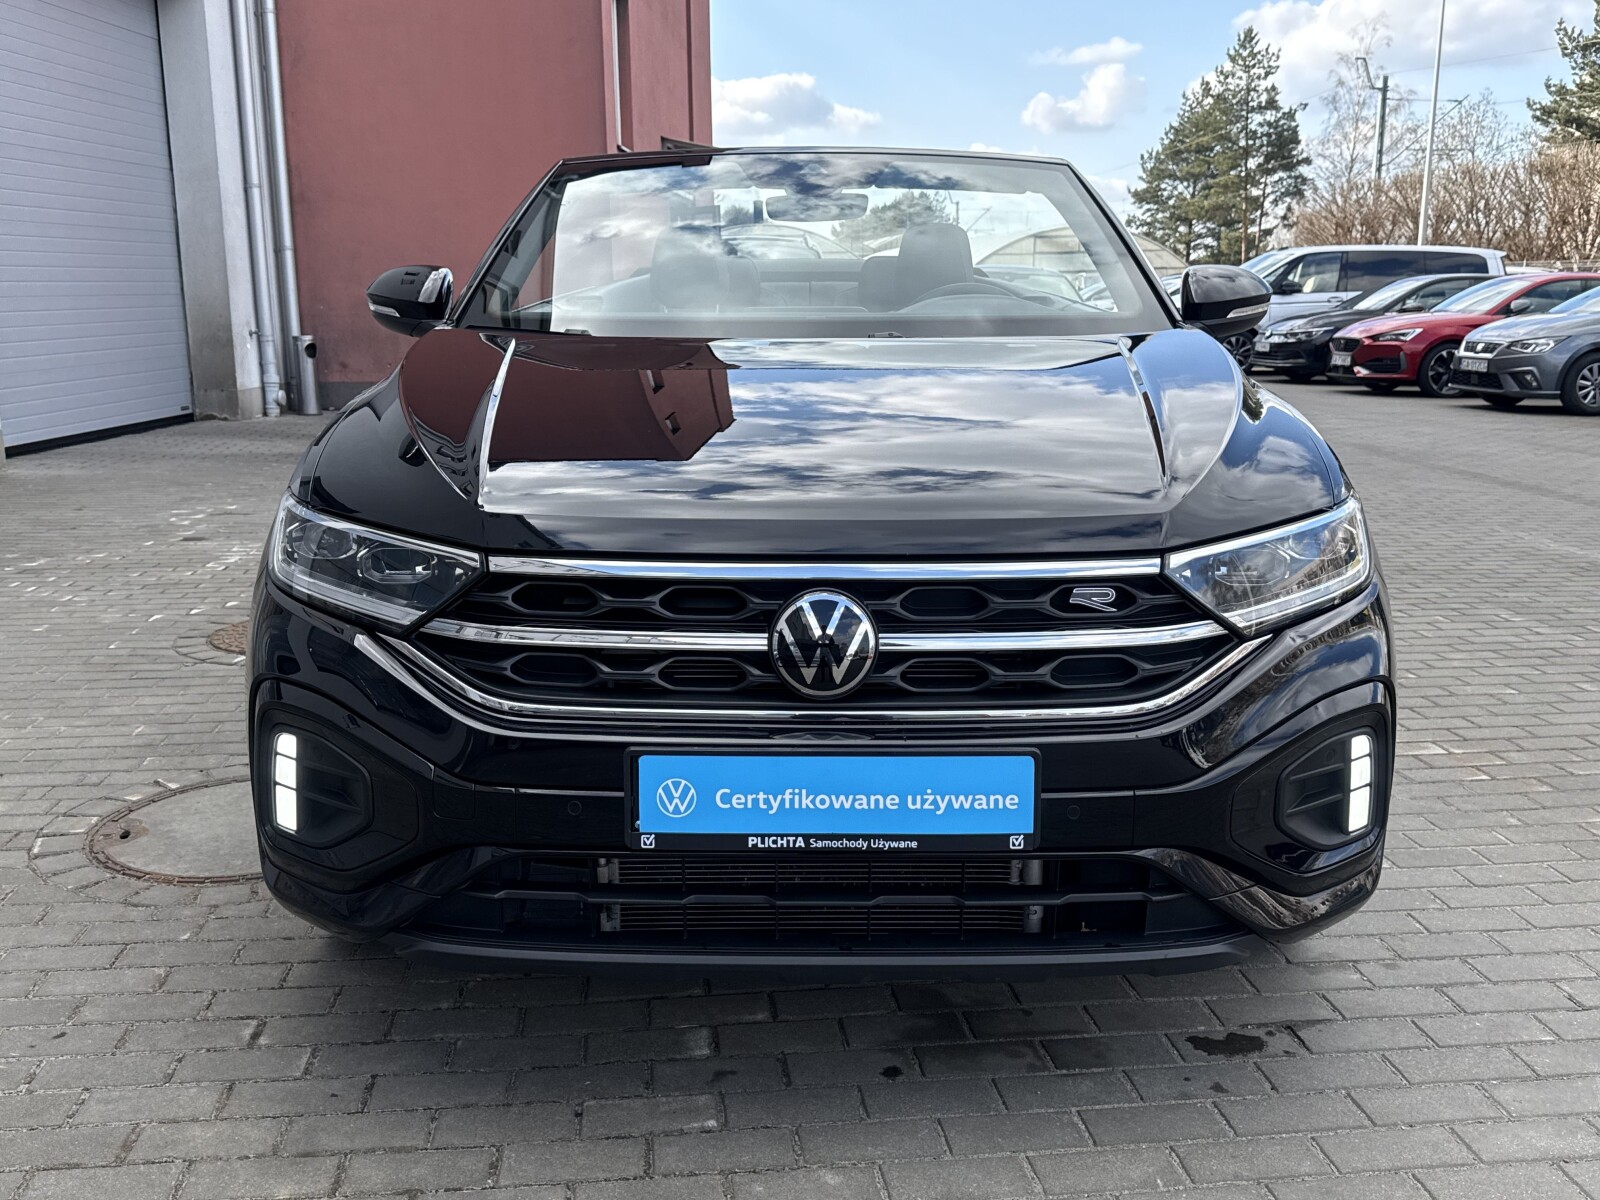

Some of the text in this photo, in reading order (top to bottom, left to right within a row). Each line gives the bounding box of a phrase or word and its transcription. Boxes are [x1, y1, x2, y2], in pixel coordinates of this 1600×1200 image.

[715, 788, 1020, 815] Certyfikowane używane
[747, 836, 918, 850] PLICHTA Samochody Używane
